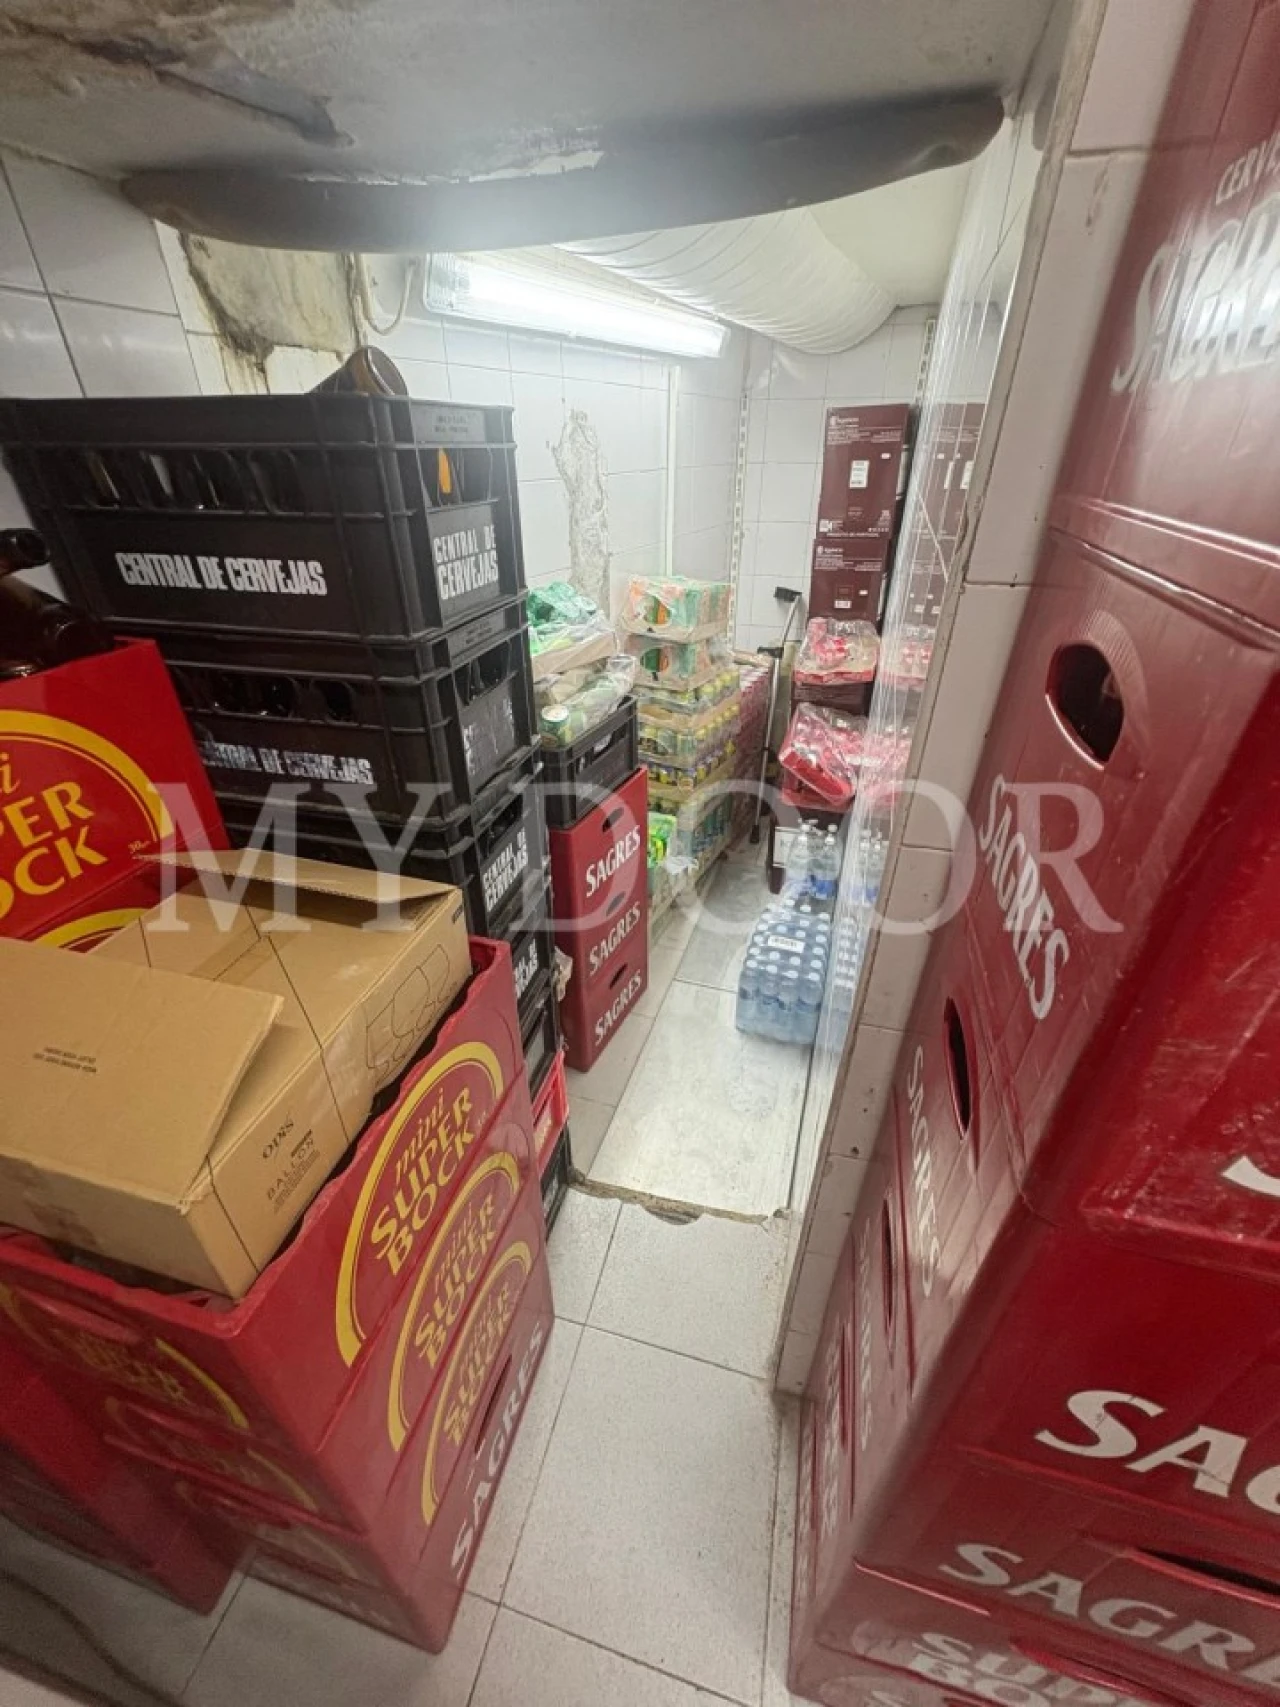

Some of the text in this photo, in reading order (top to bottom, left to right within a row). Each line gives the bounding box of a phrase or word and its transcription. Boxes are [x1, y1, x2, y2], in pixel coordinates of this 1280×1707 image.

[115, 552, 328, 596] CENTRAL DE CERVEJAS
[433, 523, 496, 563] CENTRAL DE
[437, 551, 499, 600] CERVEJAS
[483, 843, 513, 887] CENTRAL
[485, 844, 529, 913] CERVEJAS
[586, 825, 641, 898] SAGRES
[979, 773, 1070, 1020] SAGRES
[589, 901, 641, 976] SAGRES
[594, 968, 642, 1047] SAGRES
[371, 1087, 473, 1260] SUPER
[396, 1087, 444, 1187] mini
[907, 1045, 940, 1298] SAGRES
[386, 1124, 475, 1276] BOCK
[415, 1194, 494, 1358] SUPER
[425, 1230, 496, 1368] BOCK
[451, 1320, 543, 1581] SAGRES
